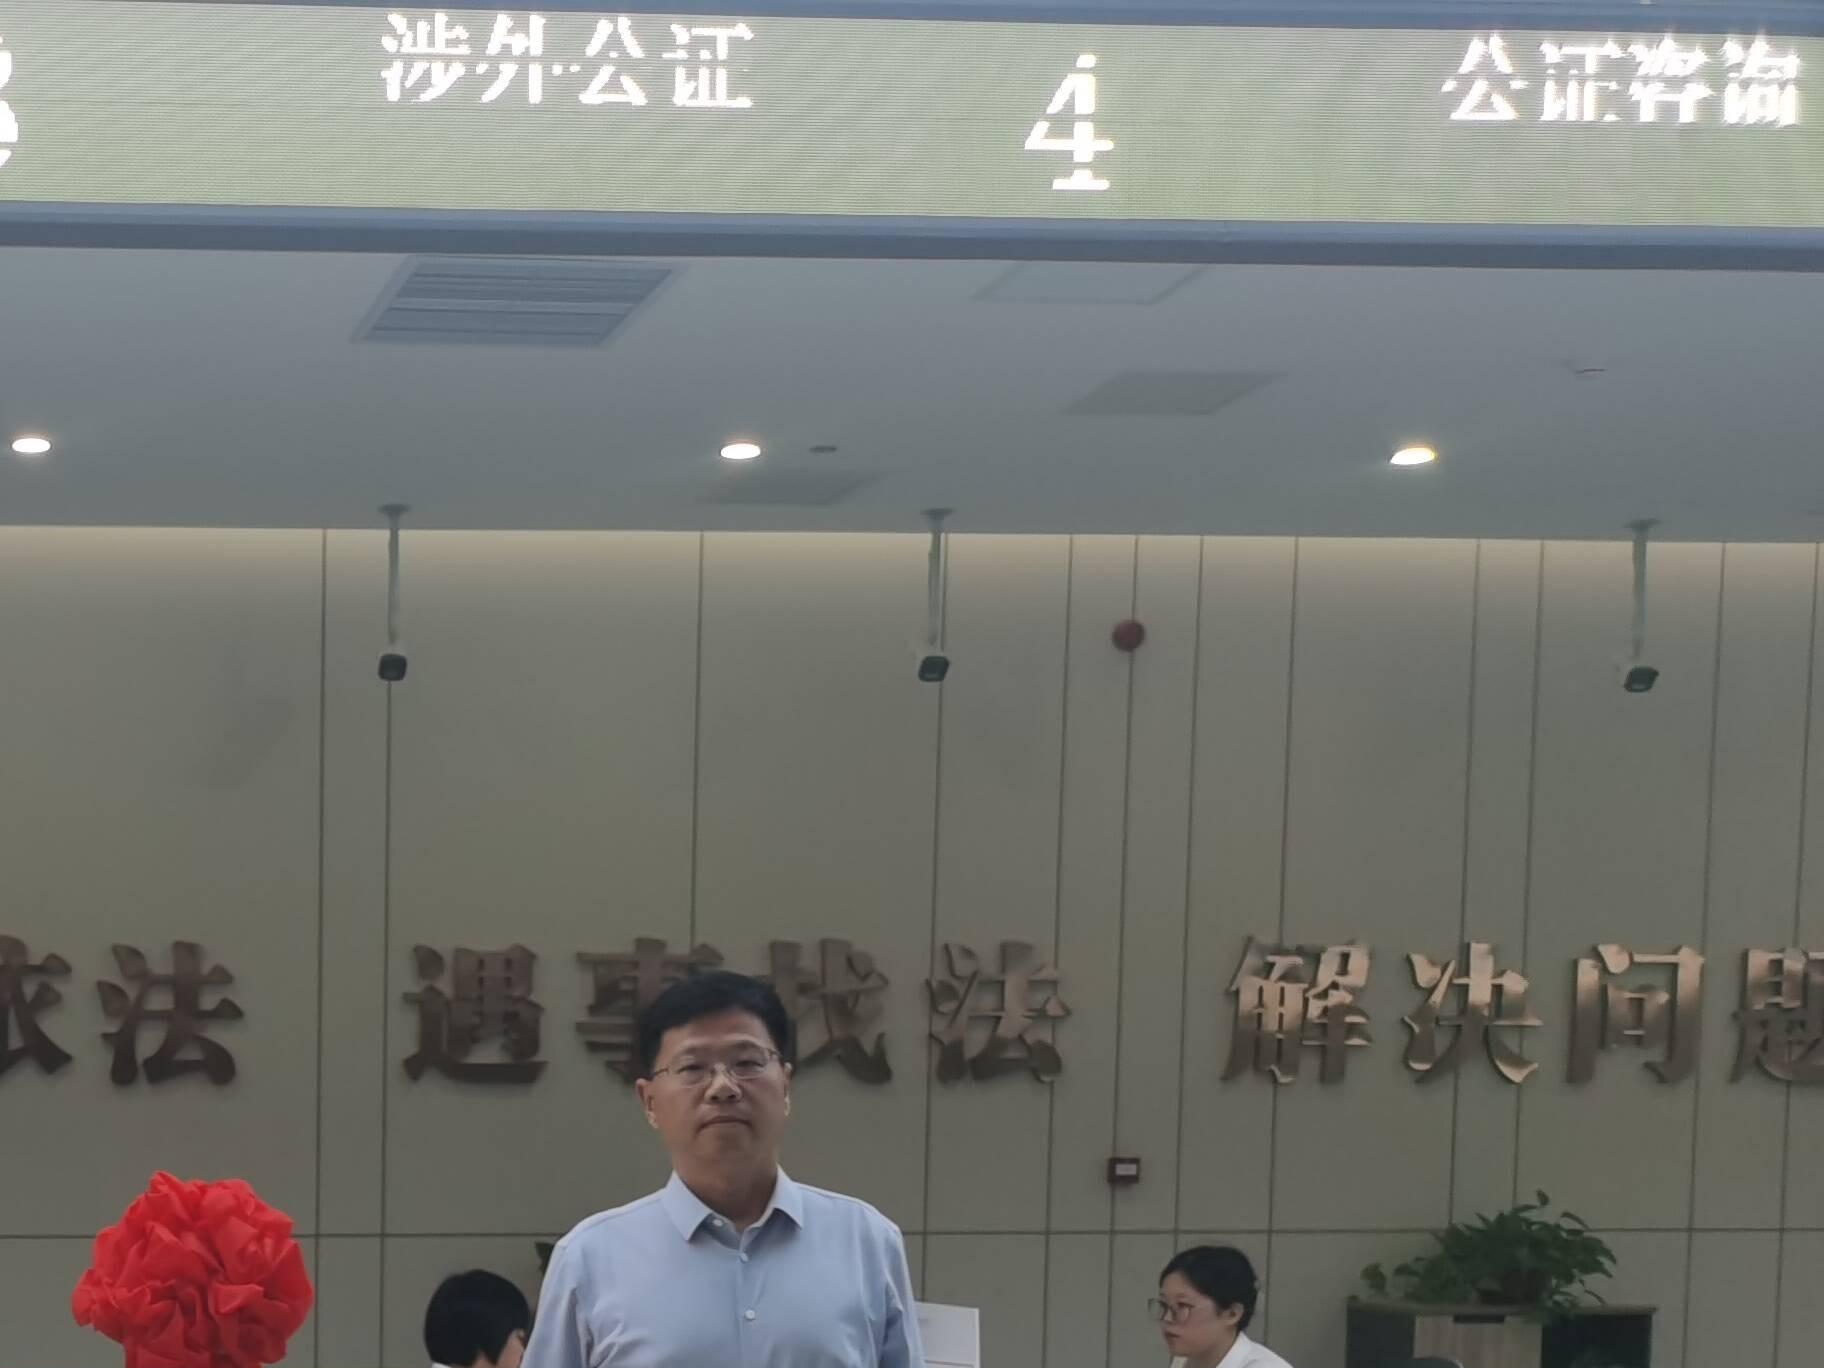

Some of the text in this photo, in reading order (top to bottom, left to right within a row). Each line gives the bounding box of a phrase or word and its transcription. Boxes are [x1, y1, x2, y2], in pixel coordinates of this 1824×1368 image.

[380, 12, 755, 109] 涉外公证
[1024, 54, 1115, 191] 4
[1441, 33, 1802, 126] 公证咨询
